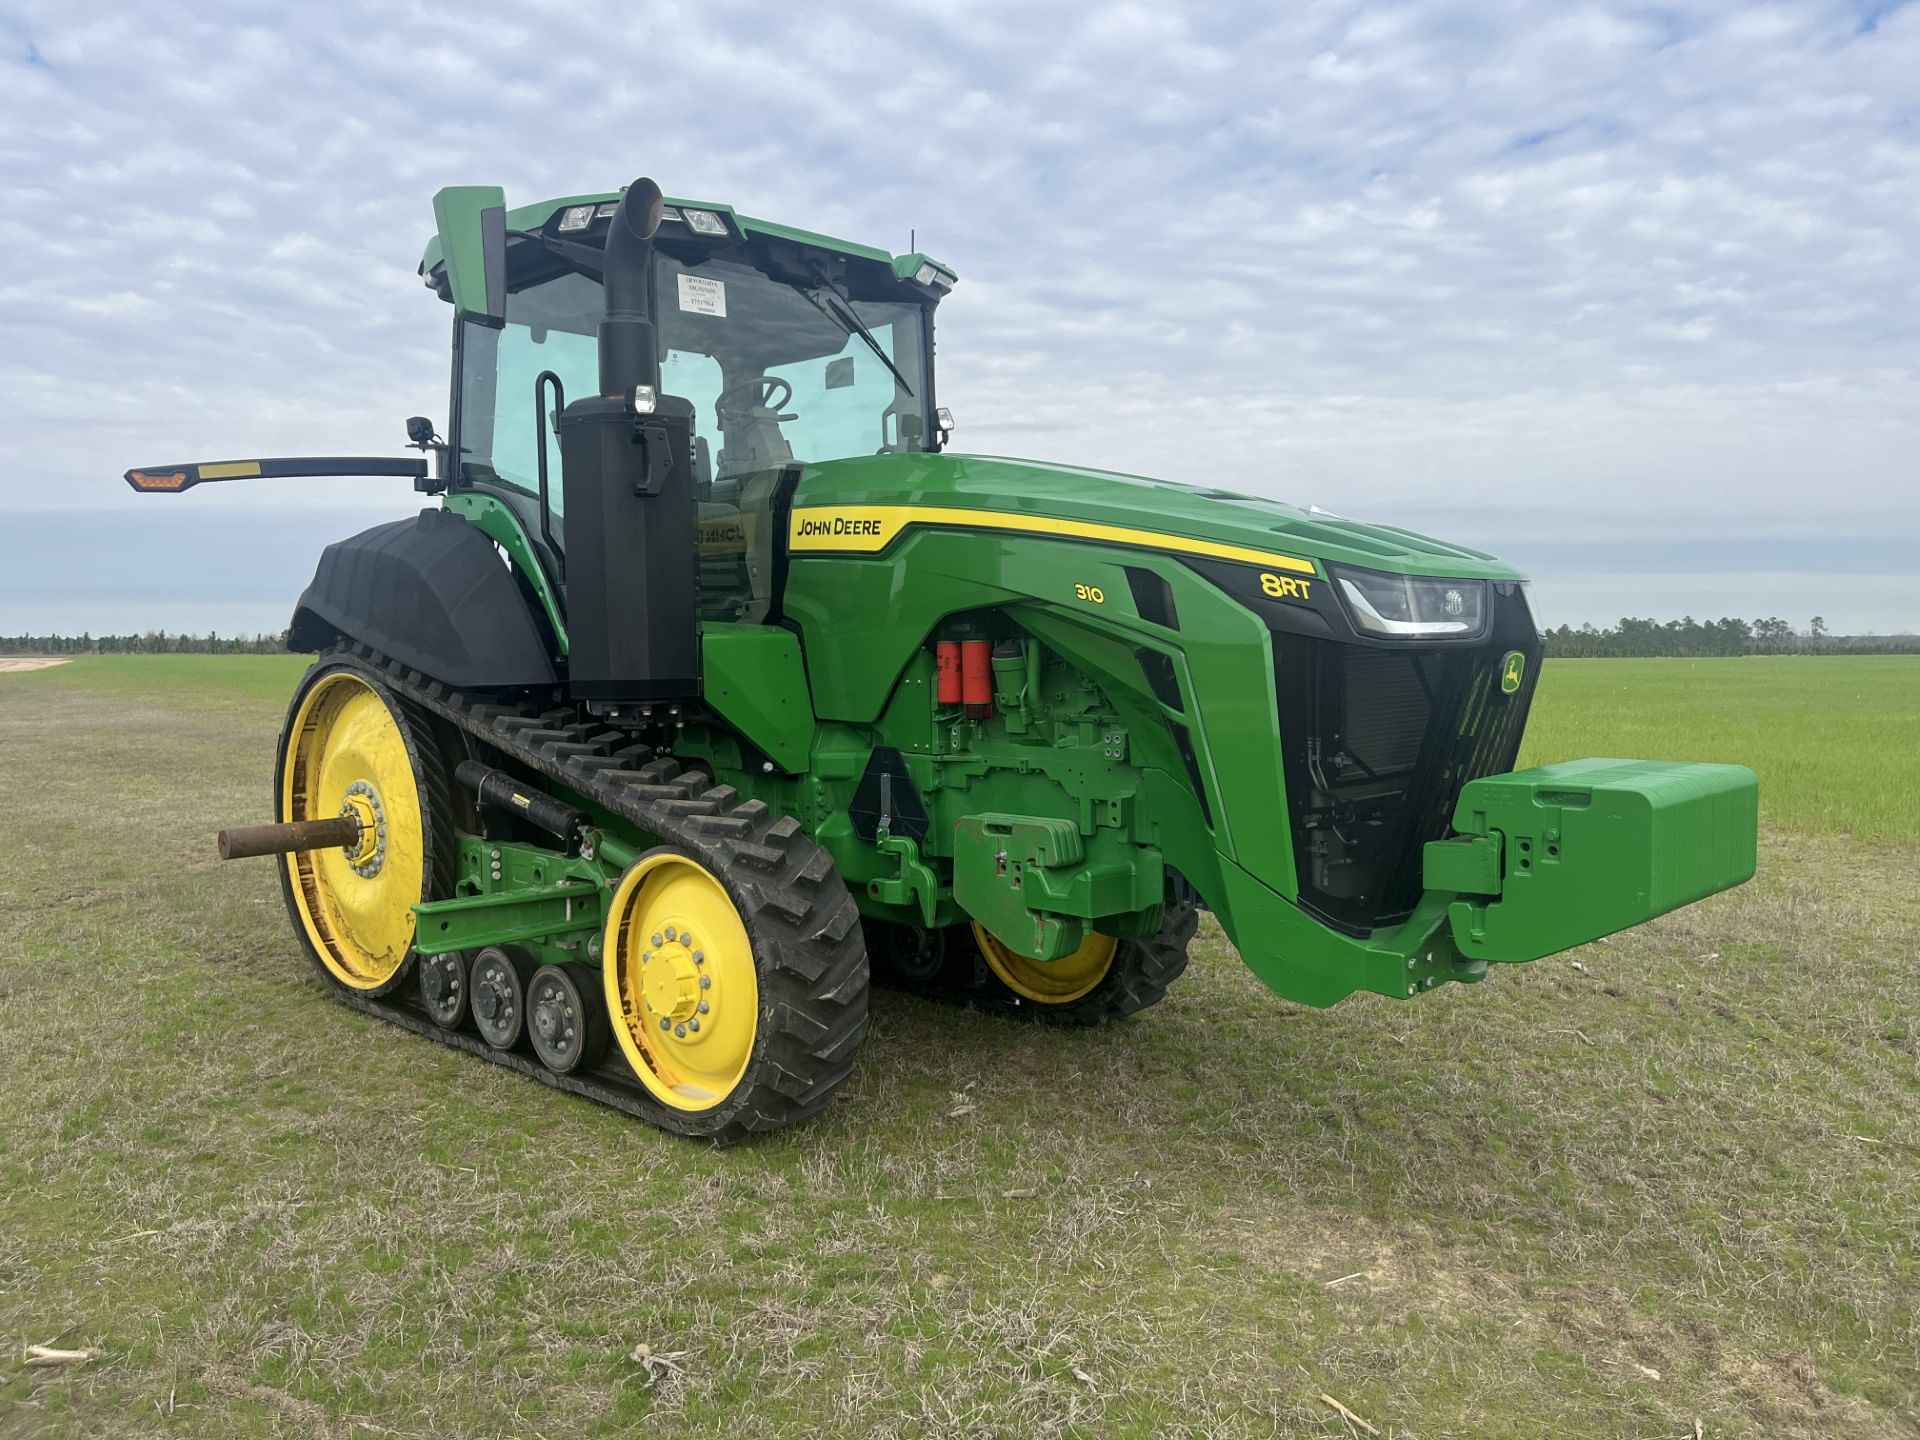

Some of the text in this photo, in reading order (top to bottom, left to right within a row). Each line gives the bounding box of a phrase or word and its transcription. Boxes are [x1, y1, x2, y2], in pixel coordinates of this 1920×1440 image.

[797, 517, 881, 536] JOHN DEERE
[1074, 583, 1104, 604] 310
[1260, 572, 1311, 600] 8RT
